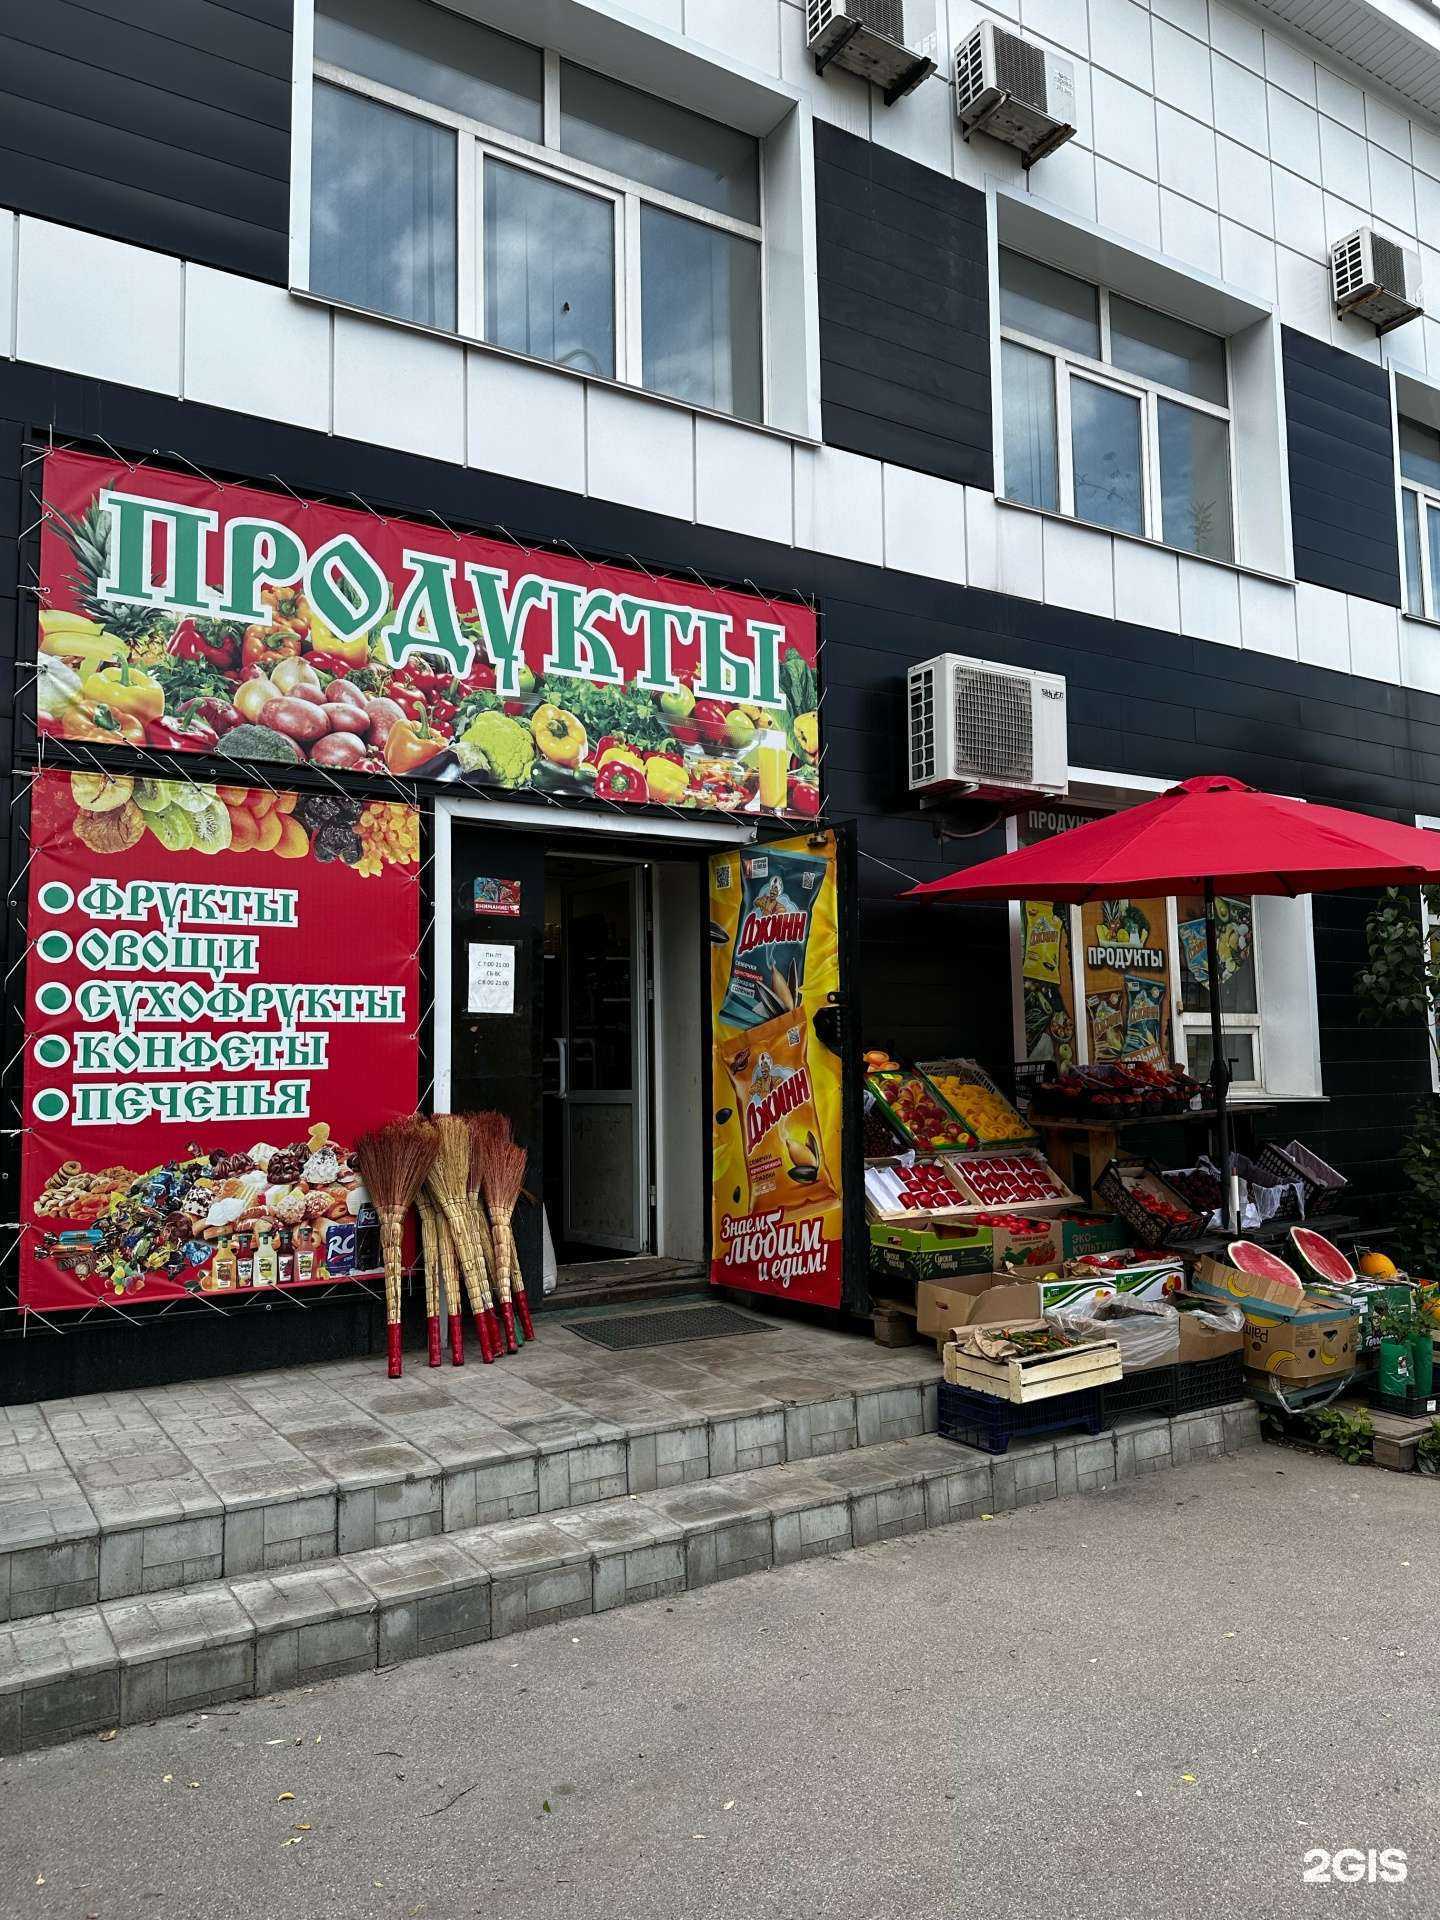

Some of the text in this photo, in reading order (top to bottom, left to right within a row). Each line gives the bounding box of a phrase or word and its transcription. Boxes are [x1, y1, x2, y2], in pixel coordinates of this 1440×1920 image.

[97, 487, 787, 711] ПРОДУКТЫ
[1028, 810, 1095, 833] ПРОДУК
[78, 878, 299, 930] ФРУКТЫ
[76, 928, 260, 981] ОВОЩИ
[738, 912, 807, 955] ДЖИНН
[1088, 946, 1163, 970] ПРОДУКТЫ
[76, 980, 405, 1029] СУХОФРУКТЫ
[73, 1031, 328, 1073] КОНФЕТЫ
[72, 1079, 310, 1125] ПЕЧЕНЬЯ
[747, 1067, 811, 1156] ДЖИНН
[327, 1232, 355, 1261] RC
[772, 1244, 828, 1288] едим!
